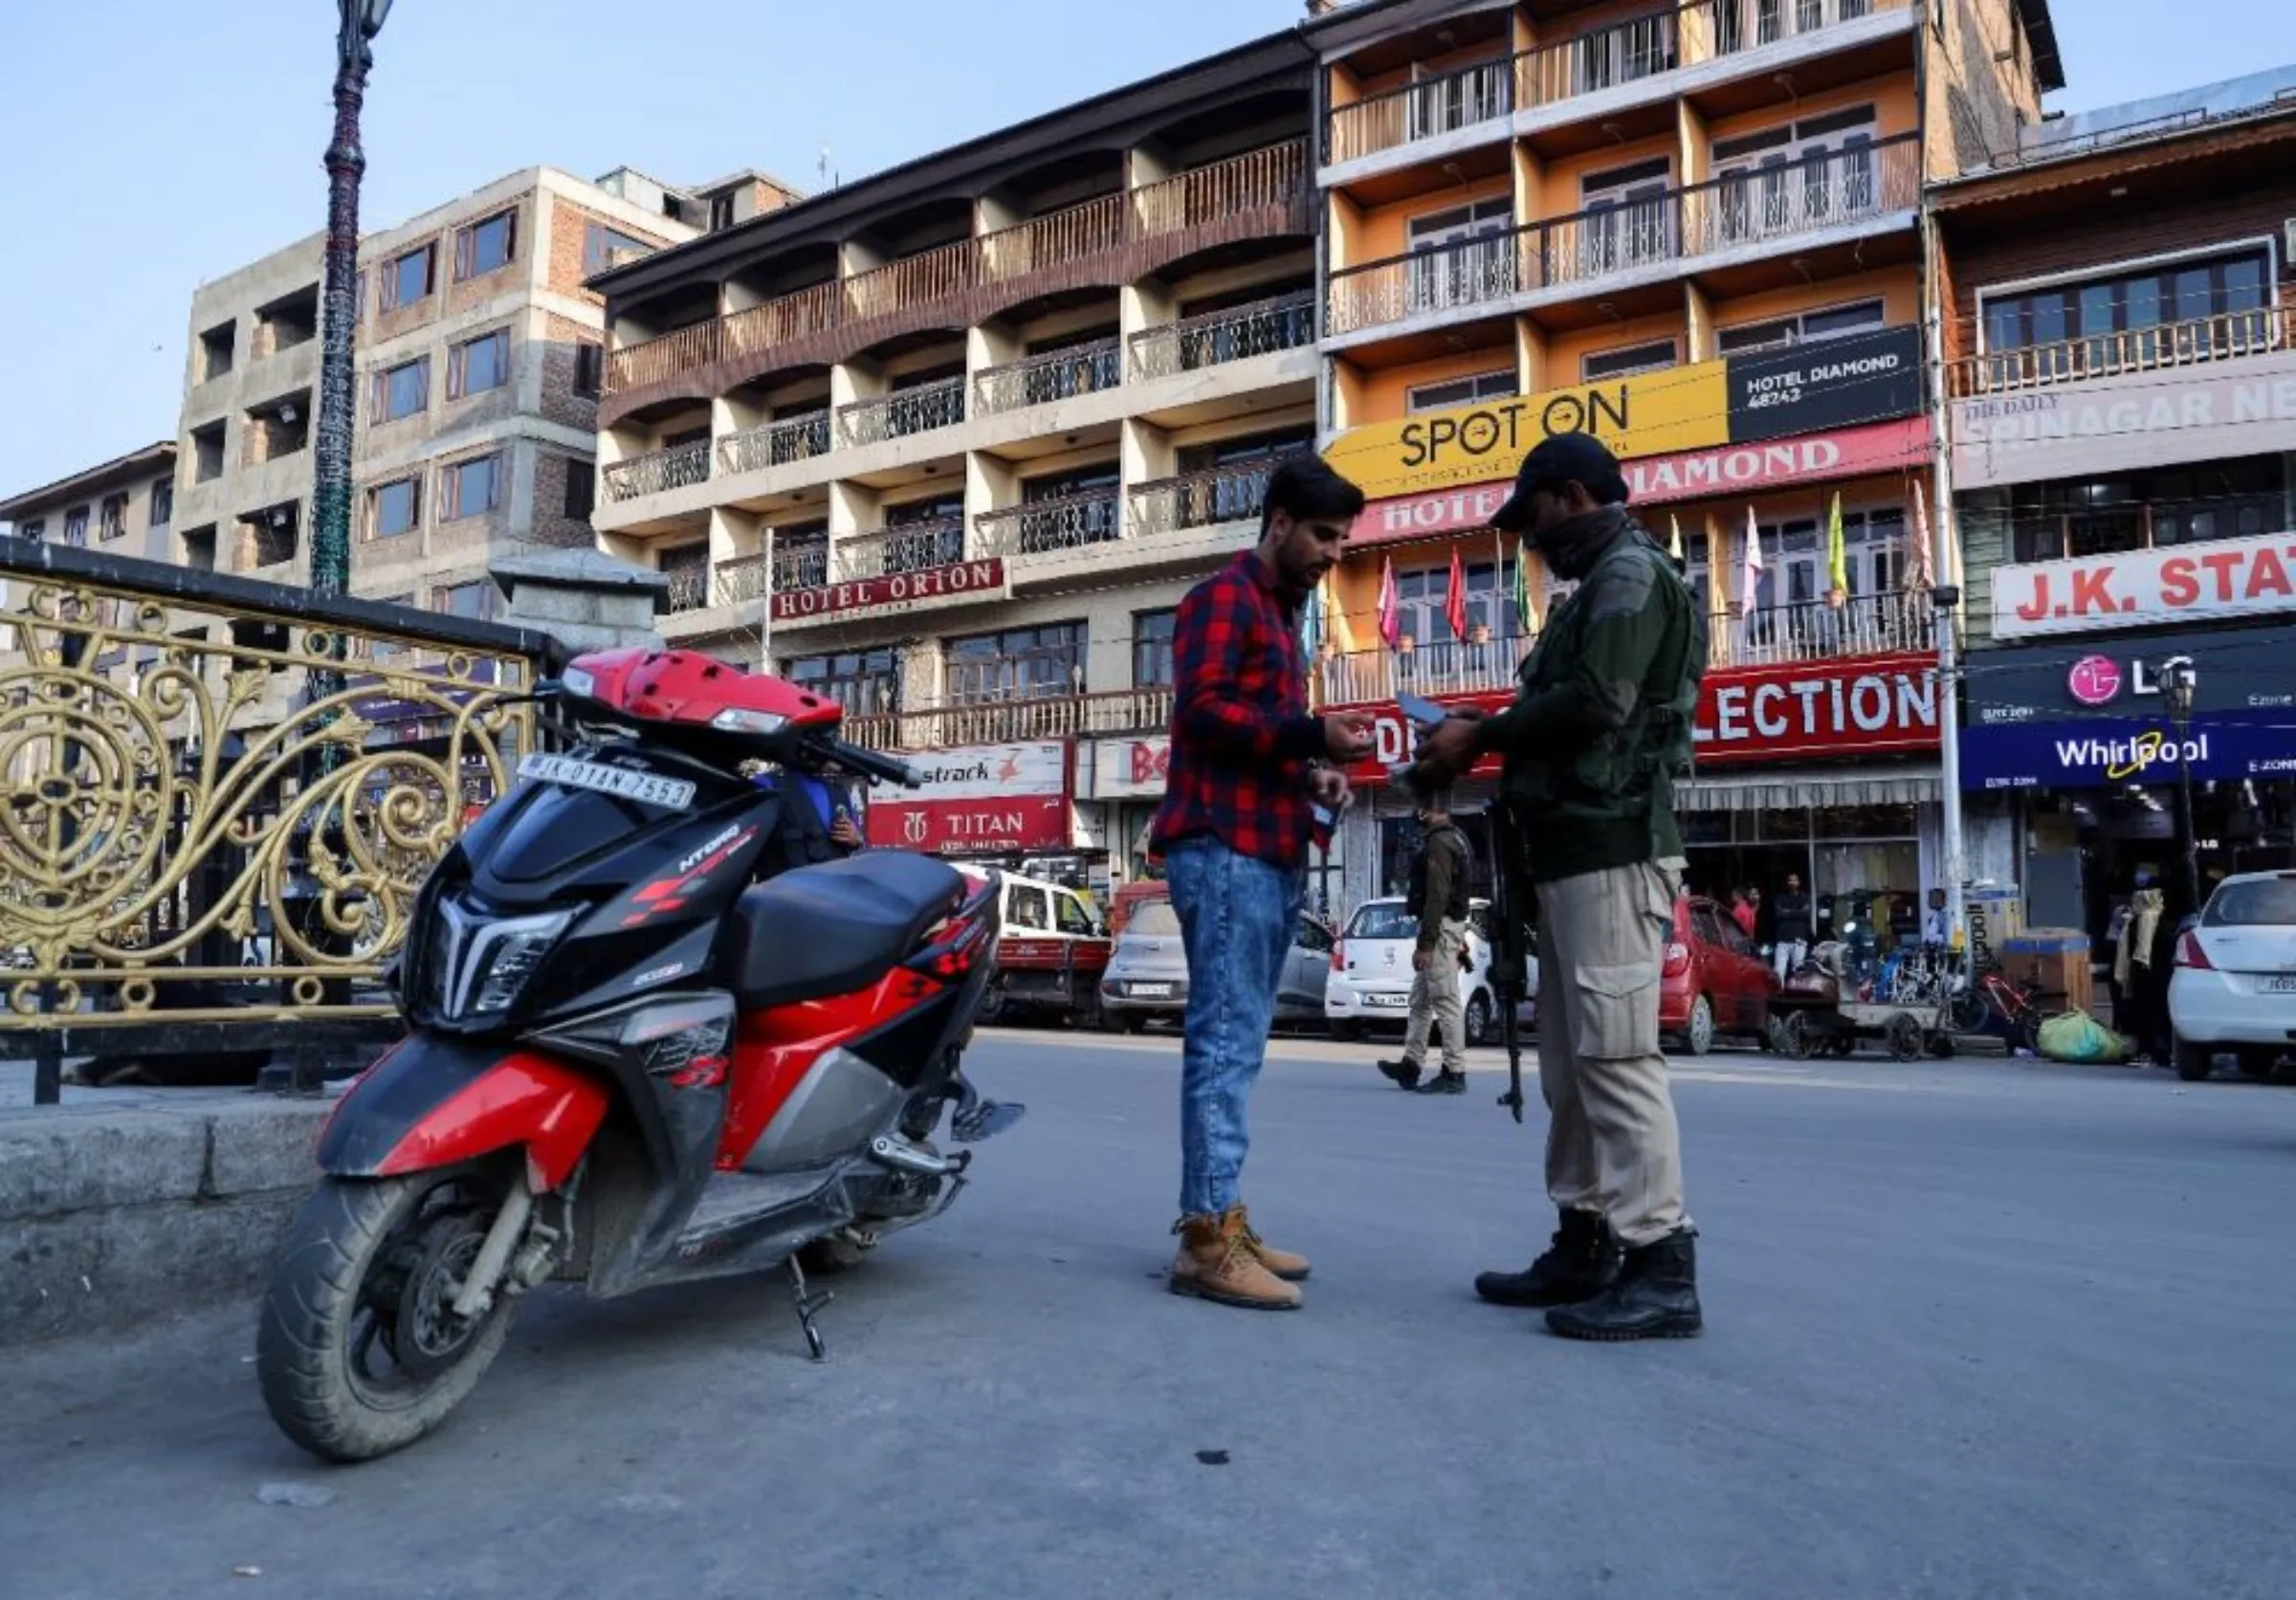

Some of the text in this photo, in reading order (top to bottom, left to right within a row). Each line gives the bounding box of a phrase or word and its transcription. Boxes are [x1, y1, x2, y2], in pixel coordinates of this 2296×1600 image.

[1747, 354, 1898, 393] HOTEL DIAMOND
[1401, 385, 1628, 467] SPOT ON
[1966, 391, 2213, 456] SRINAGAR
[2004, 392, 2058, 416] DAILY
[1383, 439, 1840, 531] HOTE IAMOND
[780, 583, 871, 616] HOTEL
[890, 563, 991, 599] ORION
[2017, 567, 2136, 621] J.K.
[922, 762, 989, 784] strack
[2055, 733, 2207, 770] Whirlpool
[946, 811, 1023, 835] TITAN
